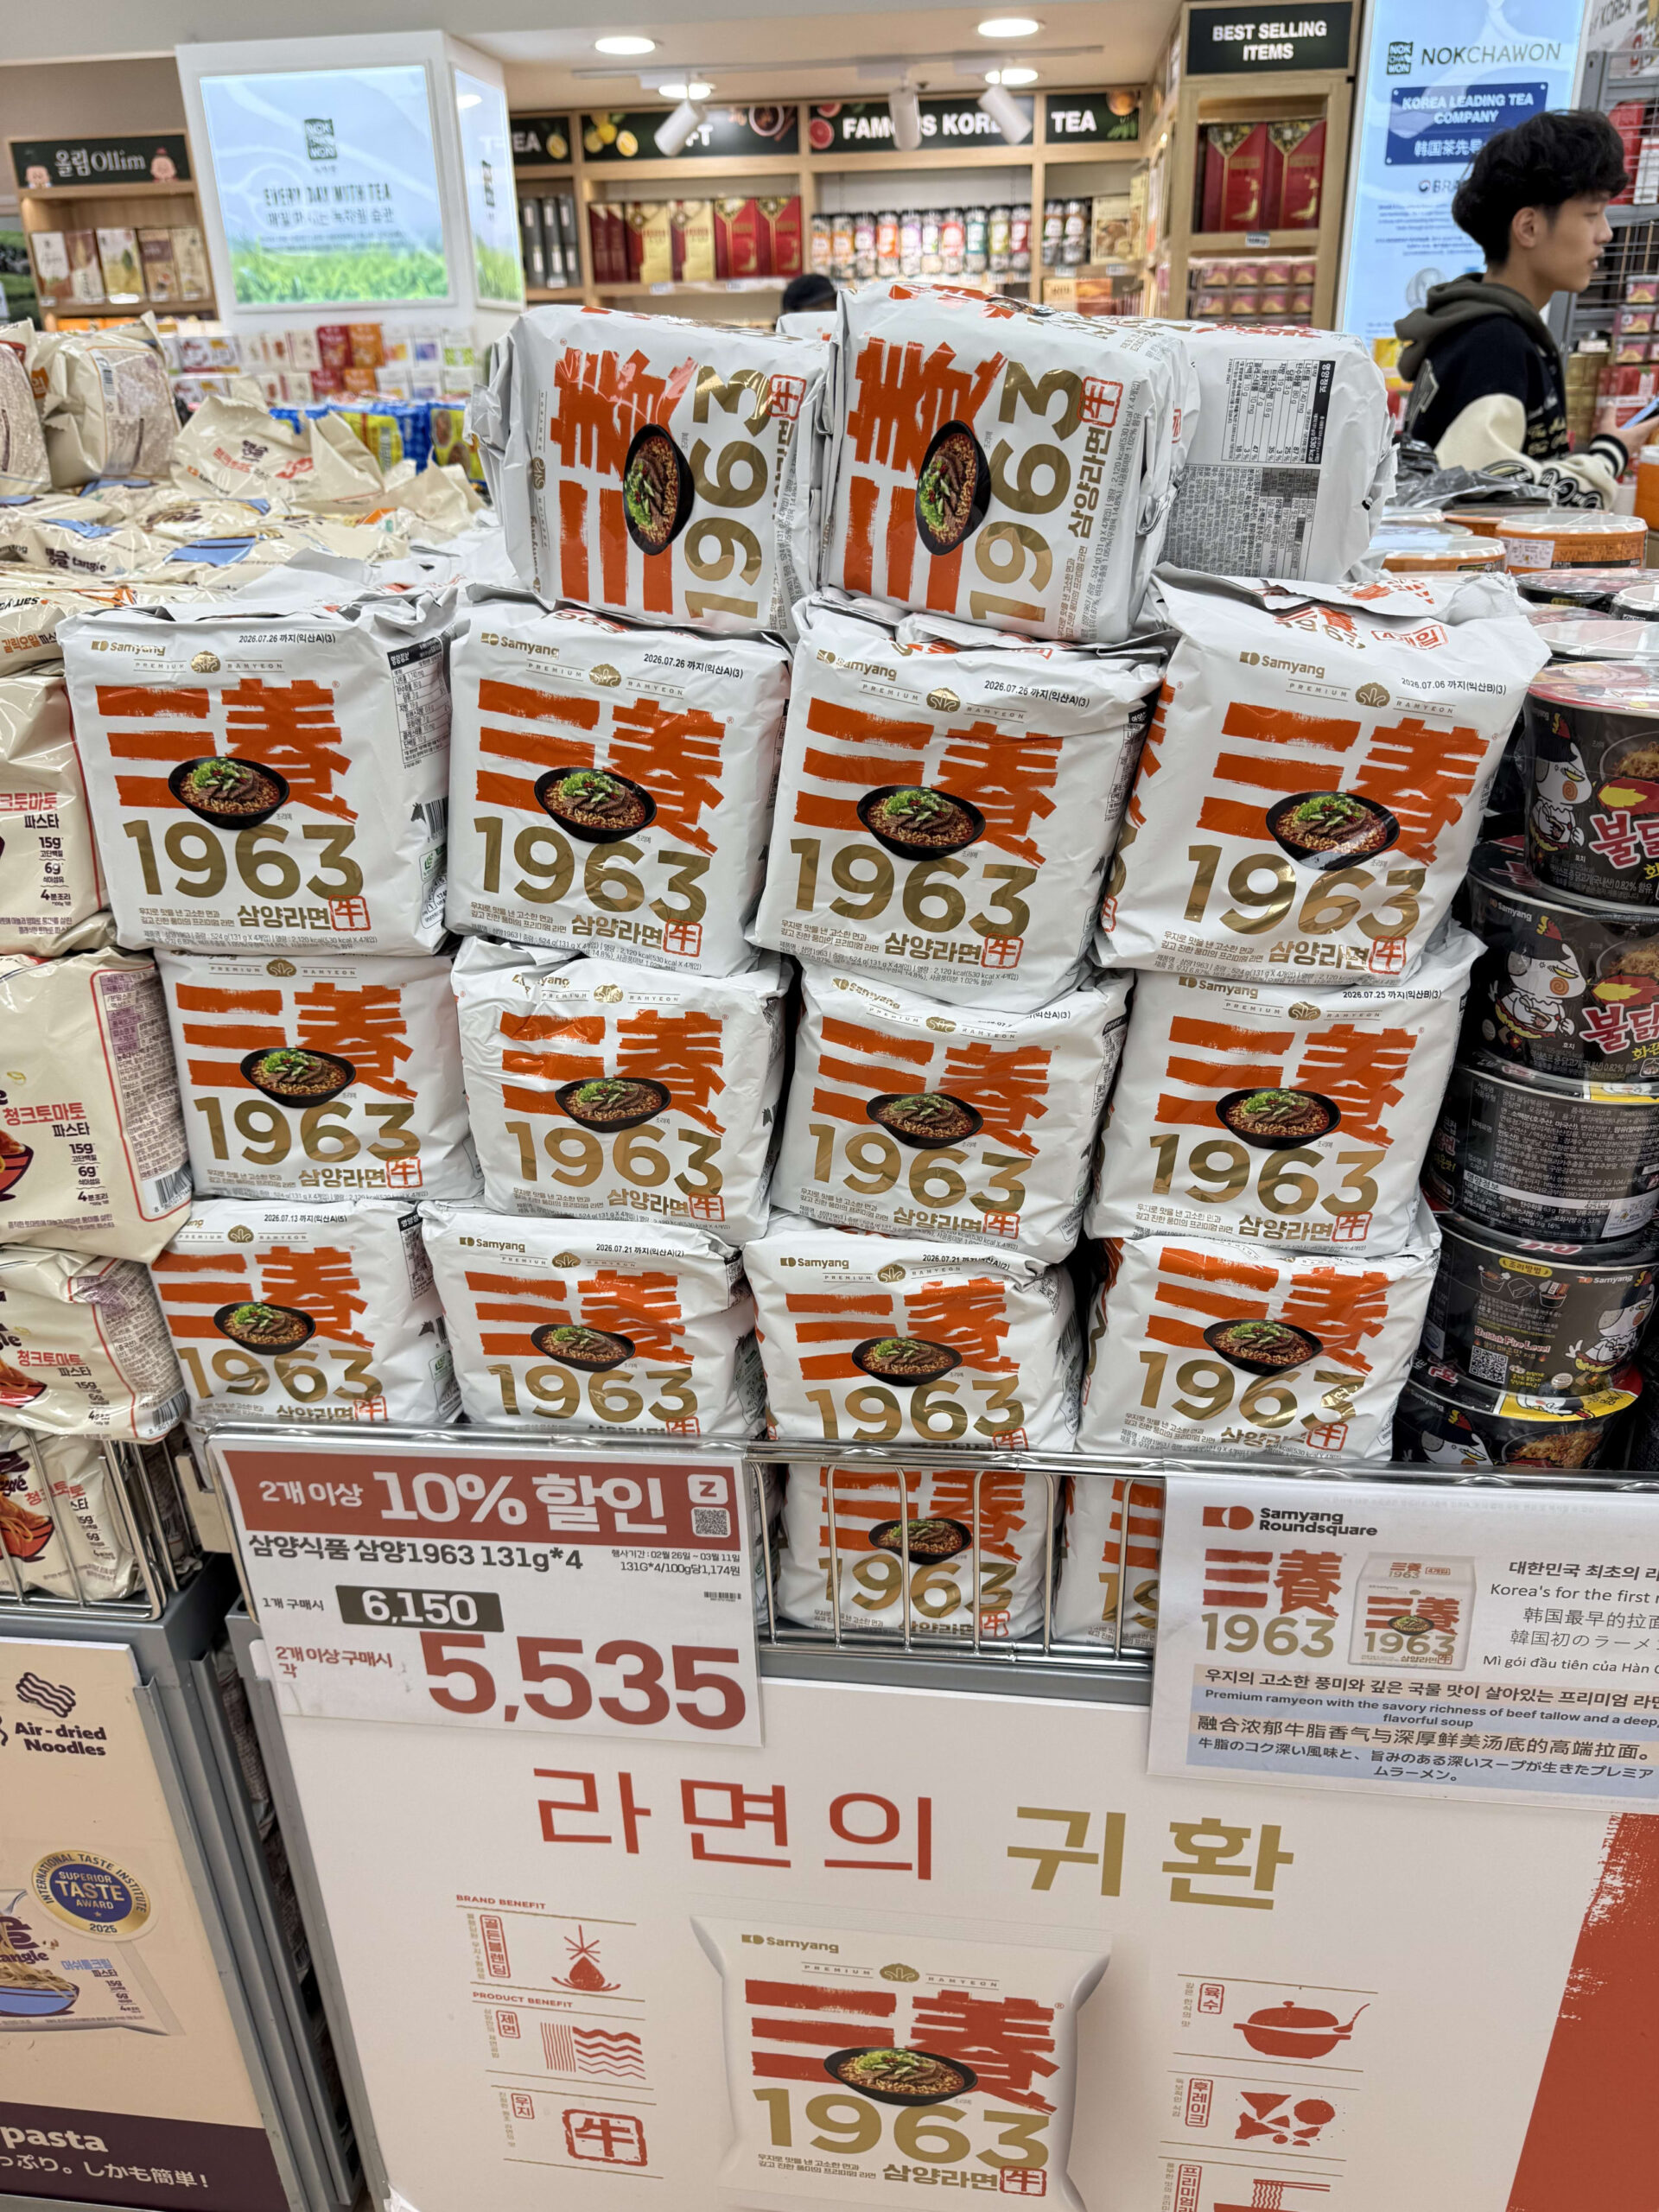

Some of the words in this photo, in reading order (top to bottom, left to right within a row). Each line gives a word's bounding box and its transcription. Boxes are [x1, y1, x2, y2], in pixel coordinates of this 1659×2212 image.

[1212, 24, 1255, 42] BEST
[1257, 20, 1327, 40] SELLING
[1242, 42, 1294, 61] ITEMS
[1421, 42, 1561, 67] NOKCHAWON
[1402, 97, 1446, 111] KOREA
[1450, 94, 1506, 108] LEADING
[1509, 92, 1534, 106] TEA
[1051, 109, 1098, 133] TEA
[1433, 111, 1499, 124] COMPANY
[264, 187, 301, 207] EVERY
[306, 186, 329, 204] DAY
[333, 184, 366, 202] WITH
[367, 182, 393, 201] TEA
[683, 365, 772, 620] 1963
[969, 360, 1083, 623] 1963
[1068, 426, 1113, 539] 삼양라면
[110, 640, 166, 657] Samyang
[238, 634, 278, 645] 2026.07.26
[500, 636, 560, 659] Samyang
[643, 653, 686, 670] 2026.07.26
[1261, 655, 1326, 679] Samyang
[984, 680, 1029, 696] 2026.07.26
[24, 813, 60, 830] 파스타
[123, 819, 365, 901] 1963
[474, 816, 711, 927] 1963
[790, 837, 1038, 939] 1963
[1183, 843, 1427, 941] 1963
[237, 905, 332, 931] 삼양라면
[571, 913, 663, 950] 삼양라면
[883, 932, 982, 967] 삼양라면
[1269, 939, 1370, 970] 삼양라면
[1198, 978, 1259, 1000] Samyang
[1342, 990, 1387, 1000] 2026.07.25
[3, 1102, 86, 1126] 청크토마토
[52, 1122, 91, 1138] 파스타
[194, 1096, 422, 1166] 1963
[505, 1120, 724, 1198] 1963
[808, 1122, 1033, 1216] 1963
[298, 1167, 386, 1189] 삼양라면
[1148, 1132, 1387, 1217] 1963
[607, 1187, 691, 1218] 삼양라면
[893, 1205, 983, 1234] 삼양라면
[1237, 1214, 1333, 1242] 삼양라면
[476, 1237, 525, 1254] Samyang
[595, 1243, 634, 1255] 2026.07.21
[797, 1257, 849, 1270] Samyang
[922, 1254, 960, 1262] 2026.07.21
[1593, 1274, 1634, 1285] Samyang
[176, 1346, 384, 1404] 1963
[486, 1363, 699, 1423] 1963
[1138, 1349, 1367, 1431] 1963
[804, 1375, 1026, 1442] 1963
[259, 1480, 306, 1506] 2개
[309, 1480, 364, 1509] 이상
[373, 1471, 530, 1526] 10%
[531, 1472, 669, 1535] 할인
[1259, 1519, 1378, 1536] Roundsquare
[1260, 1507, 1344, 1525] Samyang
[249, 1535, 350, 1560] 삼양식품
[354, 1539, 476, 1567] 삼양1963
[1509, 1560, 1580, 1578] 대한민국
[1584, 1564, 1640, 1580] 최초의
[817, 1554, 1018, 1619] 1963
[1491, 1584, 1550, 1598] Korea's
[1555, 1586, 1580, 1599] for
[1585, 1588, 1612, 1602] the
[1617, 1590, 1650, 1604] first
[263, 1597, 284, 1608] 1개
[286, 1599, 325, 1611] 구매시
[361, 1589, 479, 1626] 6,150
[1201, 1612, 1338, 1658] 1963
[1363, 1630, 1456, 1656] 1963
[1483, 1654, 1501, 1666] Mì
[1504, 1656, 1527, 1669] gói
[1530, 1655, 1557, 1669] đầu
[1561, 1659, 1589, 1670] tiên
[1622, 1662, 1650, 1674] Hàn
[420, 1631, 747, 1732] 5,535
[1205, 1669, 1255, 1685] 우지의
[1259, 1672, 1311, 1689] 고소한
[1314, 1675, 1366, 1693] 풍미와
[1370, 1679, 1404, 1695] 깊은
[1408, 1681, 1442, 1697] 국물
[1446, 1684, 1480, 1700] 맛이
[1485, 1686, 1554, 1704] 살아있는
[1558, 1691, 1629, 1708] 프리미엄
[1205, 1688, 1263, 1703] Premium
[1265, 1694, 1324, 1707] ramyeon
[1326, 1697, 1355, 1709] with
[1357, 1700, 1380, 1710] the
[1382, 1702, 1427, 1715] savory
[1429, 1704, 1487, 1717] richness
[1489, 1707, 1503, 1717] of
[1506, 1708, 1537, 1720] beef
[1540, 1711, 1581, 1723] tallow
[1583, 1713, 1609, 1724] and
[1611, 1716, 1620, 1725] a
[1382, 1713, 1438, 1727] flavorful
[1440, 1719, 1474, 1729] soup
[25, 1738, 107, 1757] Noodles
[35, 1853, 76, 1904] INTERNATIONAL
[77, 1853, 115, 1872] TASTE
[115, 1869, 147, 1913] INSTITUTE
[58, 1871, 112, 1884] SUPERIOR
[54, 1879, 125, 1902] TASTE
[455, 1894, 496, 1905] BRAND
[499, 1898, 547, 1910] BENEFIT
[76, 1898, 114, 1910] AWARD
[90, 1923, 118, 1933] 2025
[766, 1936, 839, 1954] Samyang
[472, 1991, 524, 2004] PRODUCT
[527, 1997, 574, 2009] BENEFIT
[0, 2126, 109, 2152] pasta
[752, 2087, 1050, 2170] 1963
[882, 2164, 998, 2192] 삼양라면
